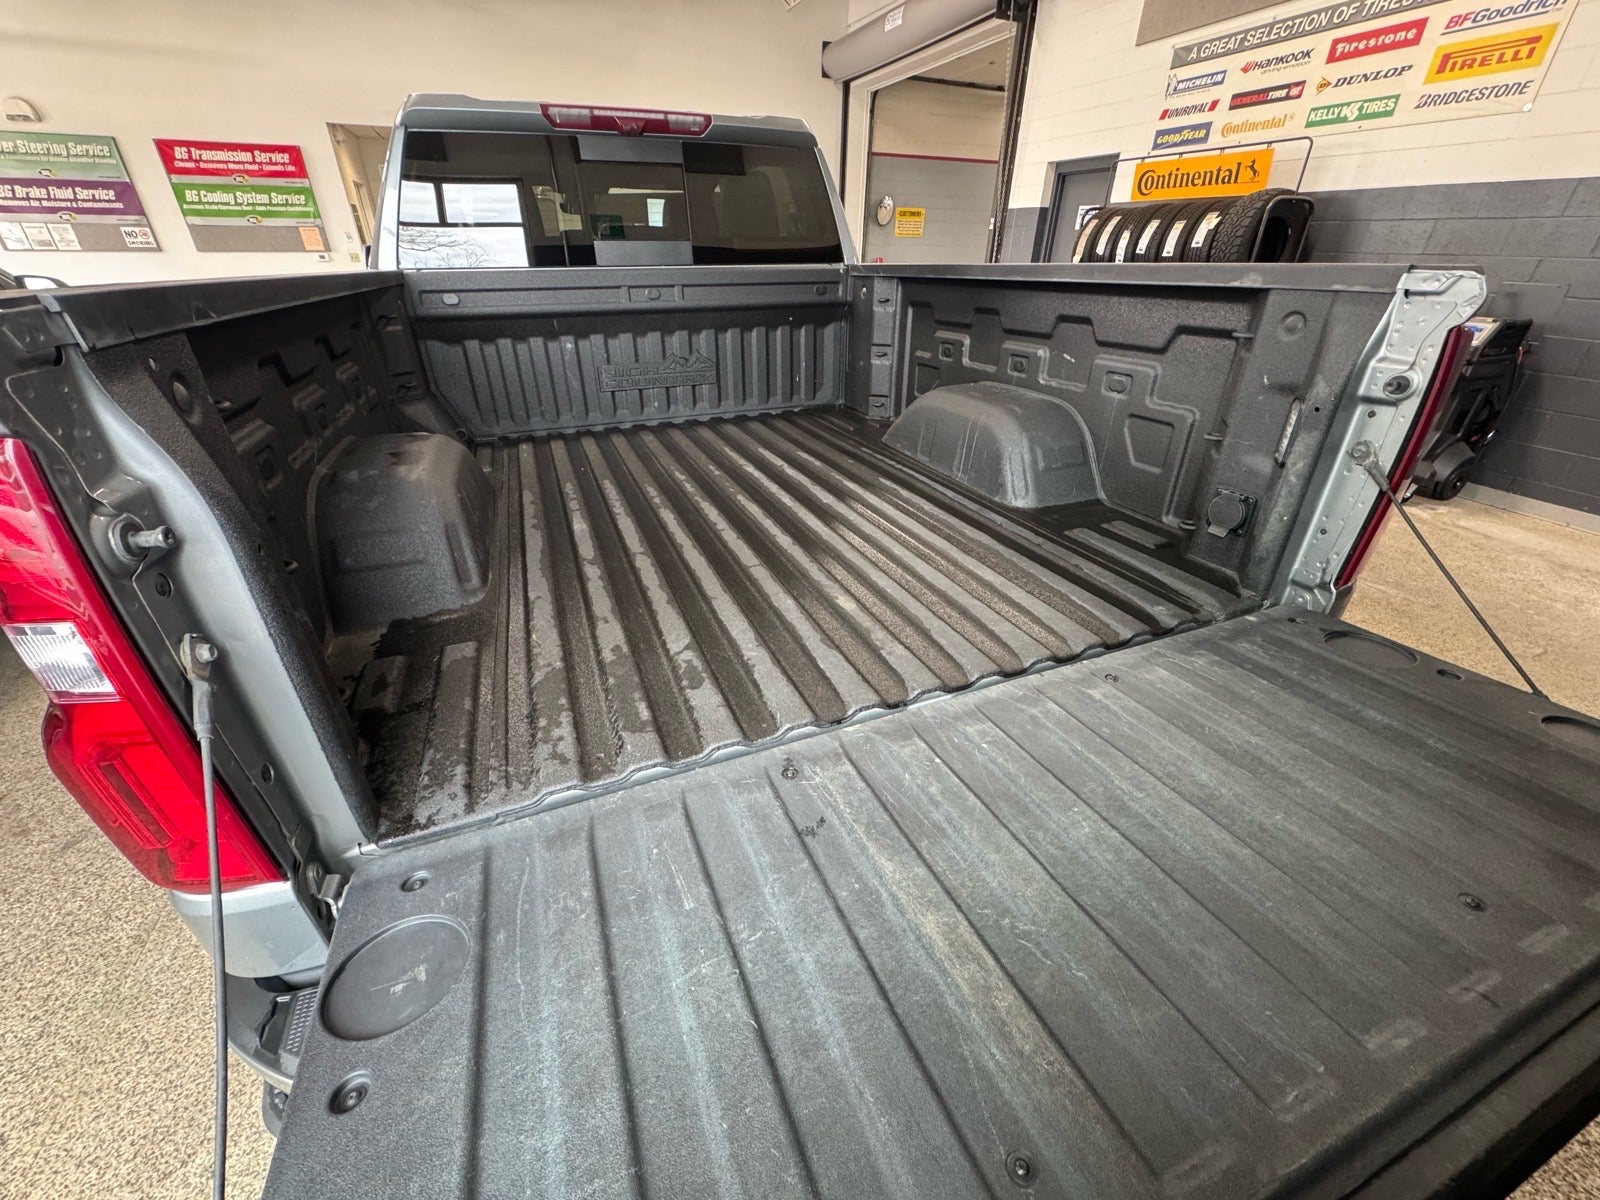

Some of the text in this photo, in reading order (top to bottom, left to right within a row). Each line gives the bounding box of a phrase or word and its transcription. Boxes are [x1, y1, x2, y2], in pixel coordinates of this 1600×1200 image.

[1187, 46, 1199, 61] A
[1200, 34, 1245, 58] GREAT
[1244, 11, 1331, 47] SELECTION
[1333, 2, 1362, 24] OF
[1335, 28, 1418, 58] Firestone
[1435, 35, 1543, 75] PIRELLI
[1176, 72, 1225, 91] MICHELIN
[1332, 64, 1414, 89] DUNLOP
[1230, 92, 1268, 107] GENERAL
[1267, 88, 1289, 100] TIRE
[1414, 80, 1535, 110] BRIDGESTONE
[1167, 101, 1209, 119] UNIROYAL
[1308, 106, 1342, 122] KELLY
[1361, 98, 1397, 115] TIRES
[1221, 113, 1288, 138] Continental
[1156, 128, 1207, 145] GOODYEAR
[16, 139, 68, 157] Steering
[67, 142, 111, 157] Service
[174, 146, 290, 163] BG Transmission Service
[1137, 161, 1242, 196] Continental
[13, 185, 48, 199] Brake
[48, 186, 75, 200] Fluid
[75, 187, 116, 201] Service
[185, 189, 306, 206] BG Cooling System Service
[123, 229, 138, 240] NO
[602, 373, 714, 389] COUNTRY
